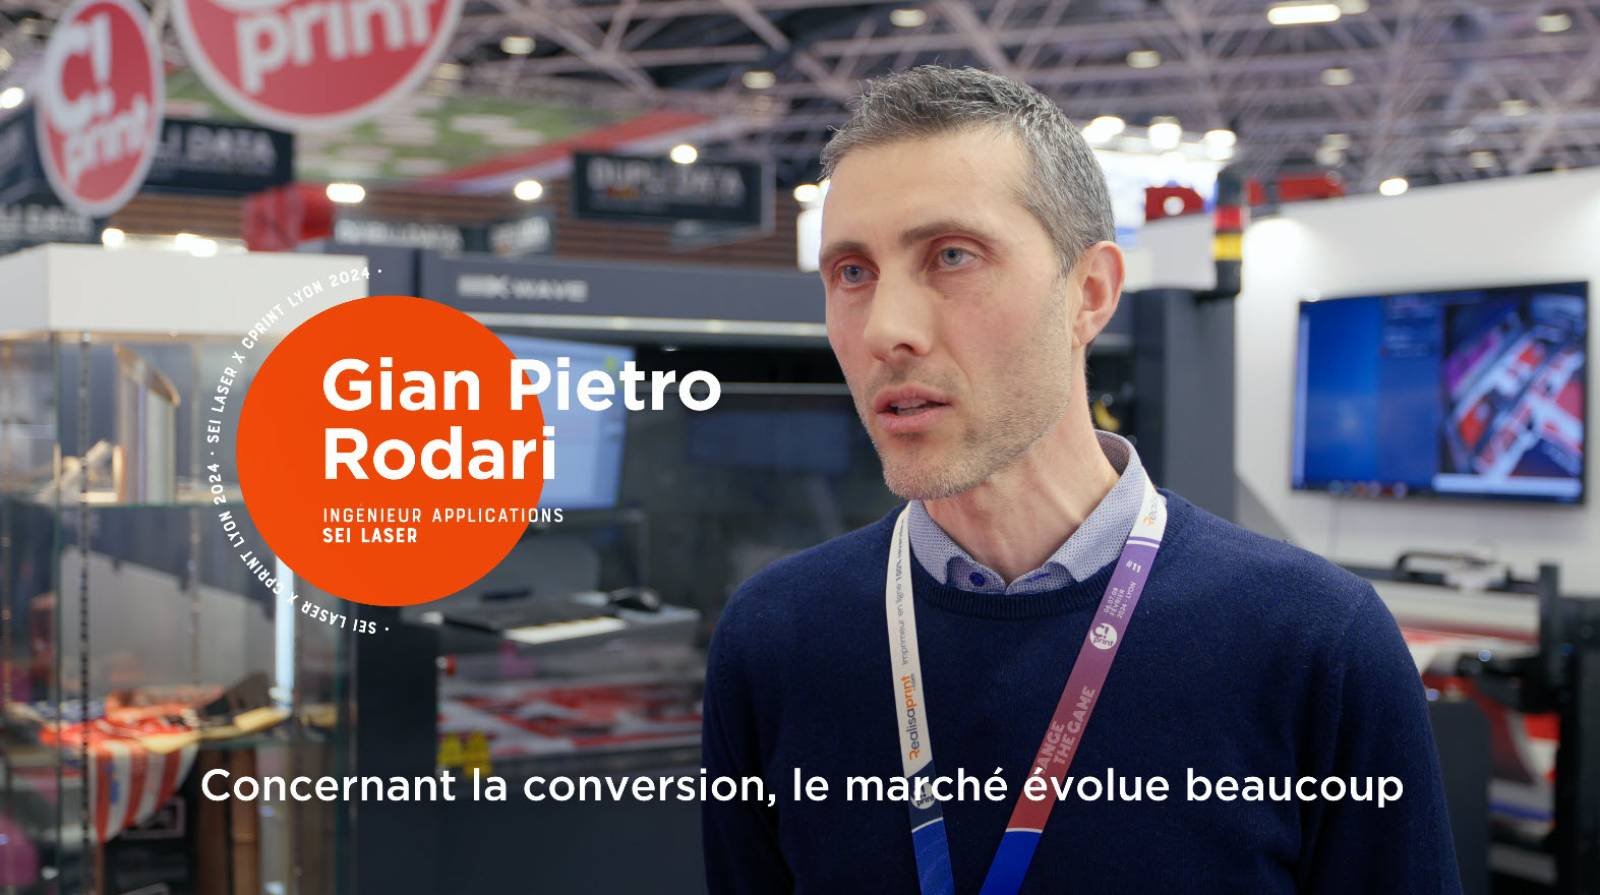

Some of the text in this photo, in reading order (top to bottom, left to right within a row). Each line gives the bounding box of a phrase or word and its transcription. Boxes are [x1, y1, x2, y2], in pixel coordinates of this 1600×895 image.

[237, 0, 433, 94] print
[64, 92, 148, 188] print
[901, 673, 920, 761] Realisaprint
[1052, 685, 1097, 765] THE GAME
